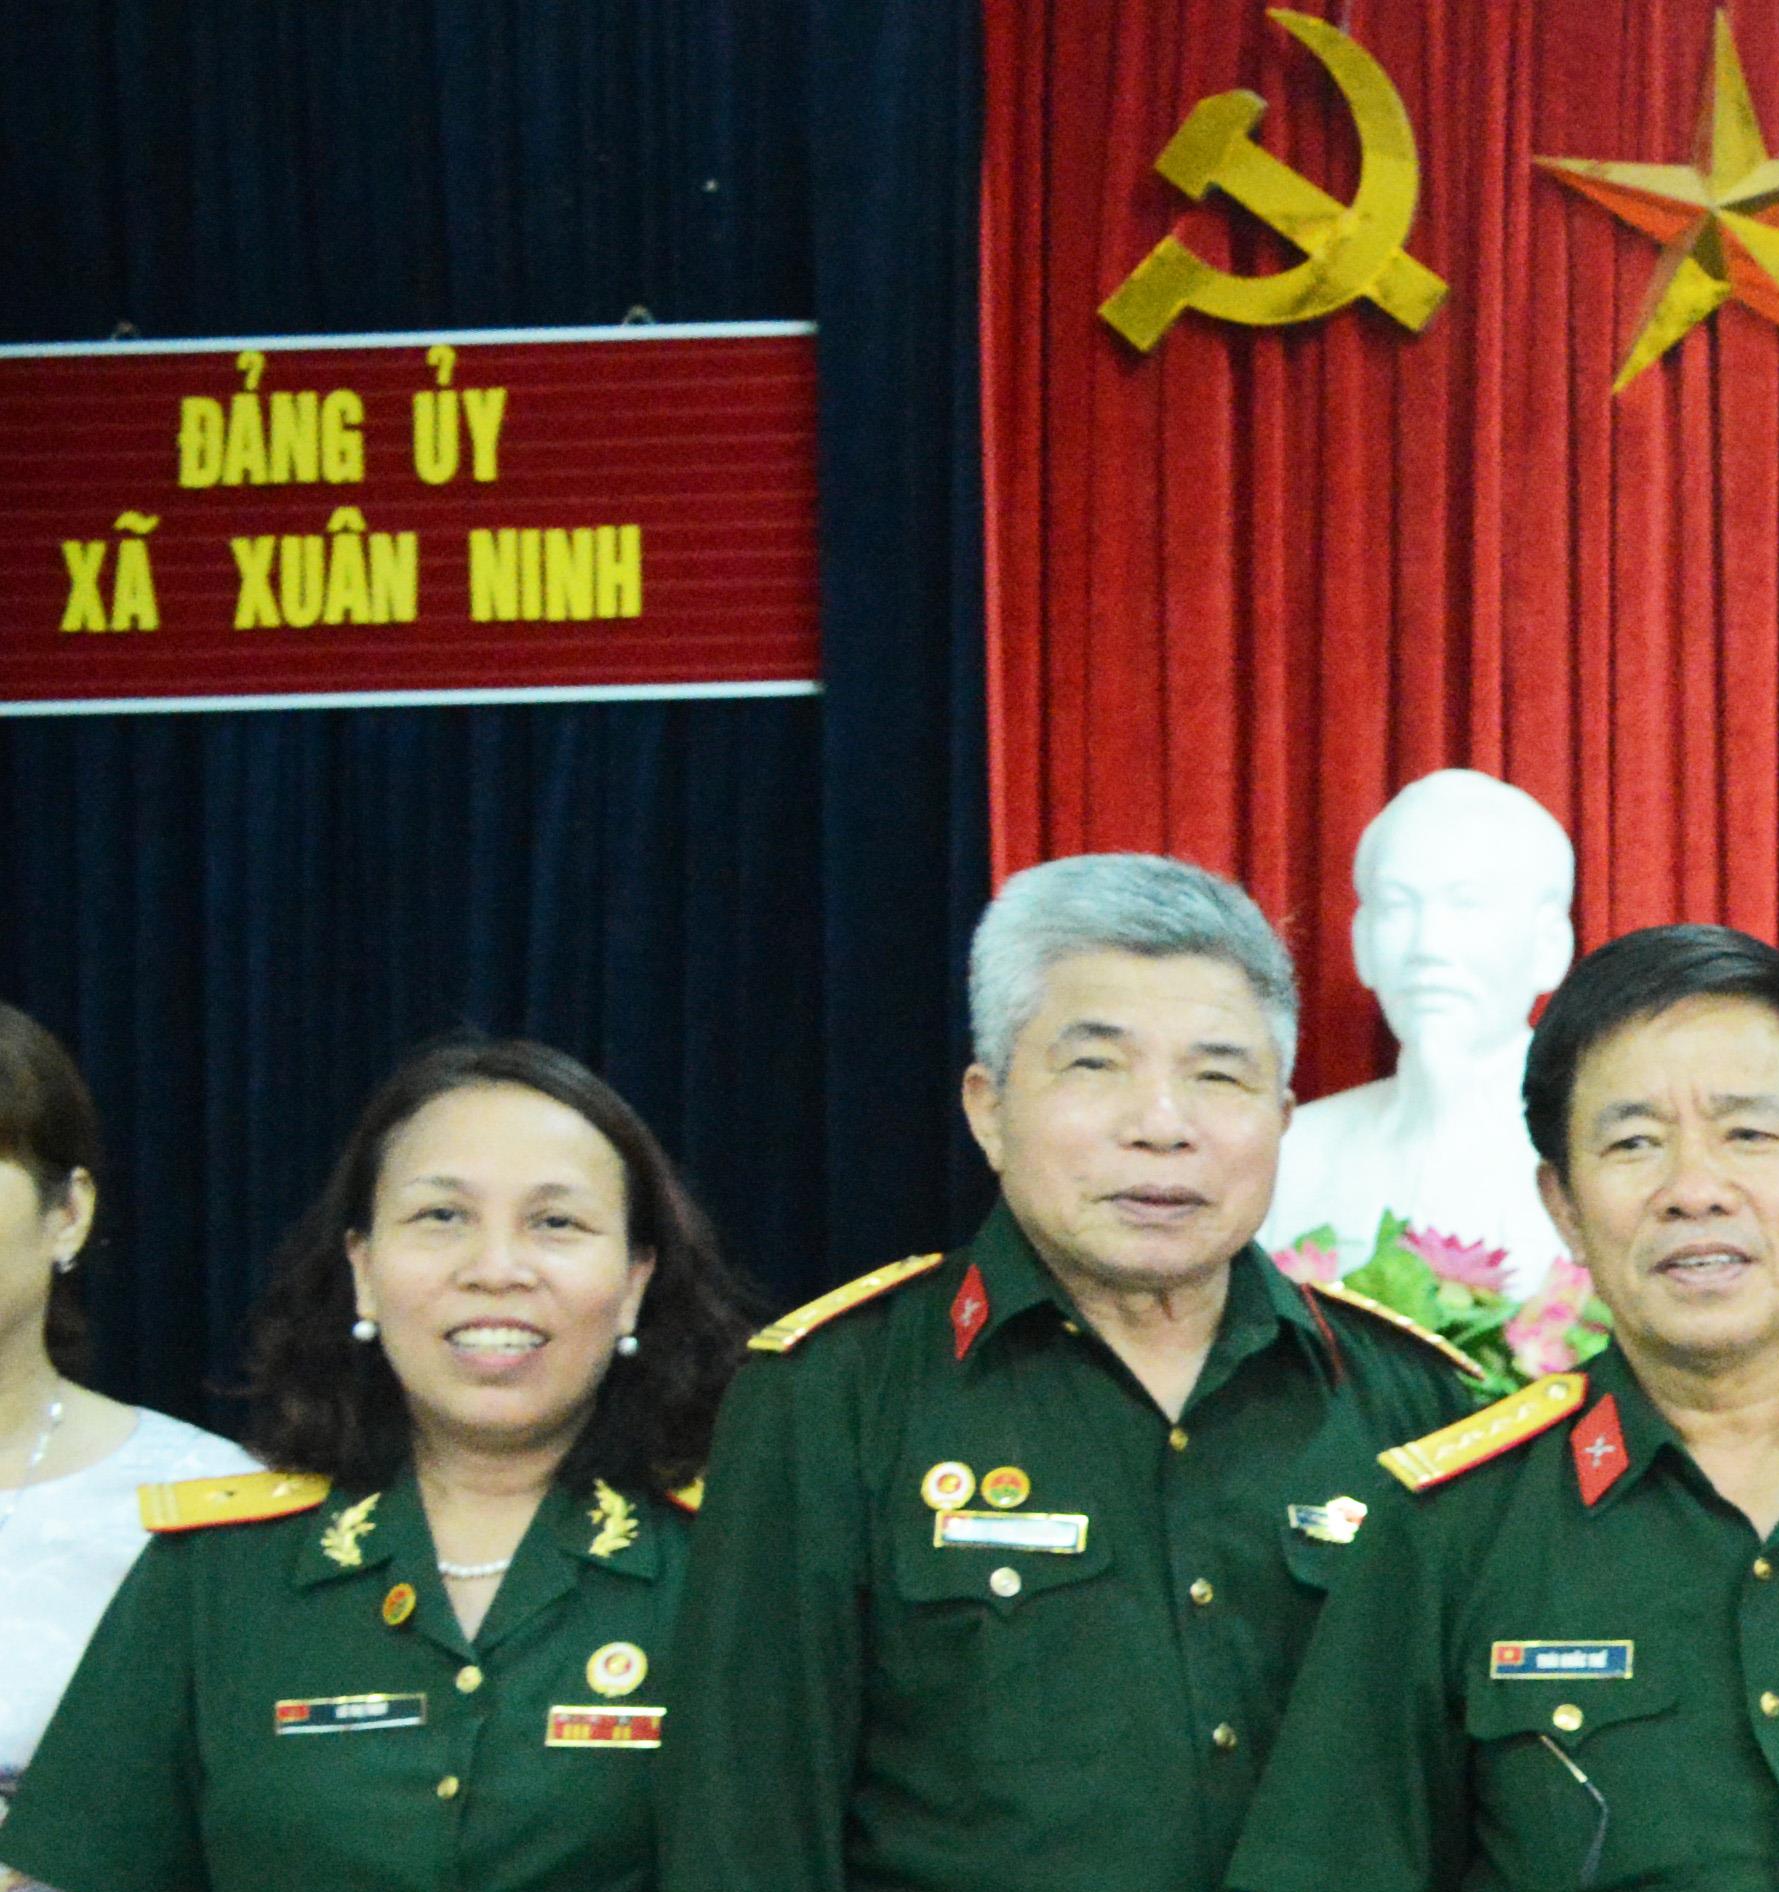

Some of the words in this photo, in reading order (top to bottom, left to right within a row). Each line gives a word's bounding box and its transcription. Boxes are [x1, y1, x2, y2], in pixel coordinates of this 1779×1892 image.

[178, 350, 367, 488] ĐẢNG
[412, 344, 508, 485] ỦY
[59, 510, 160, 632] XÃ
[230, 506, 419, 630] XUÂN
[468, 524, 644, 622] NINH
